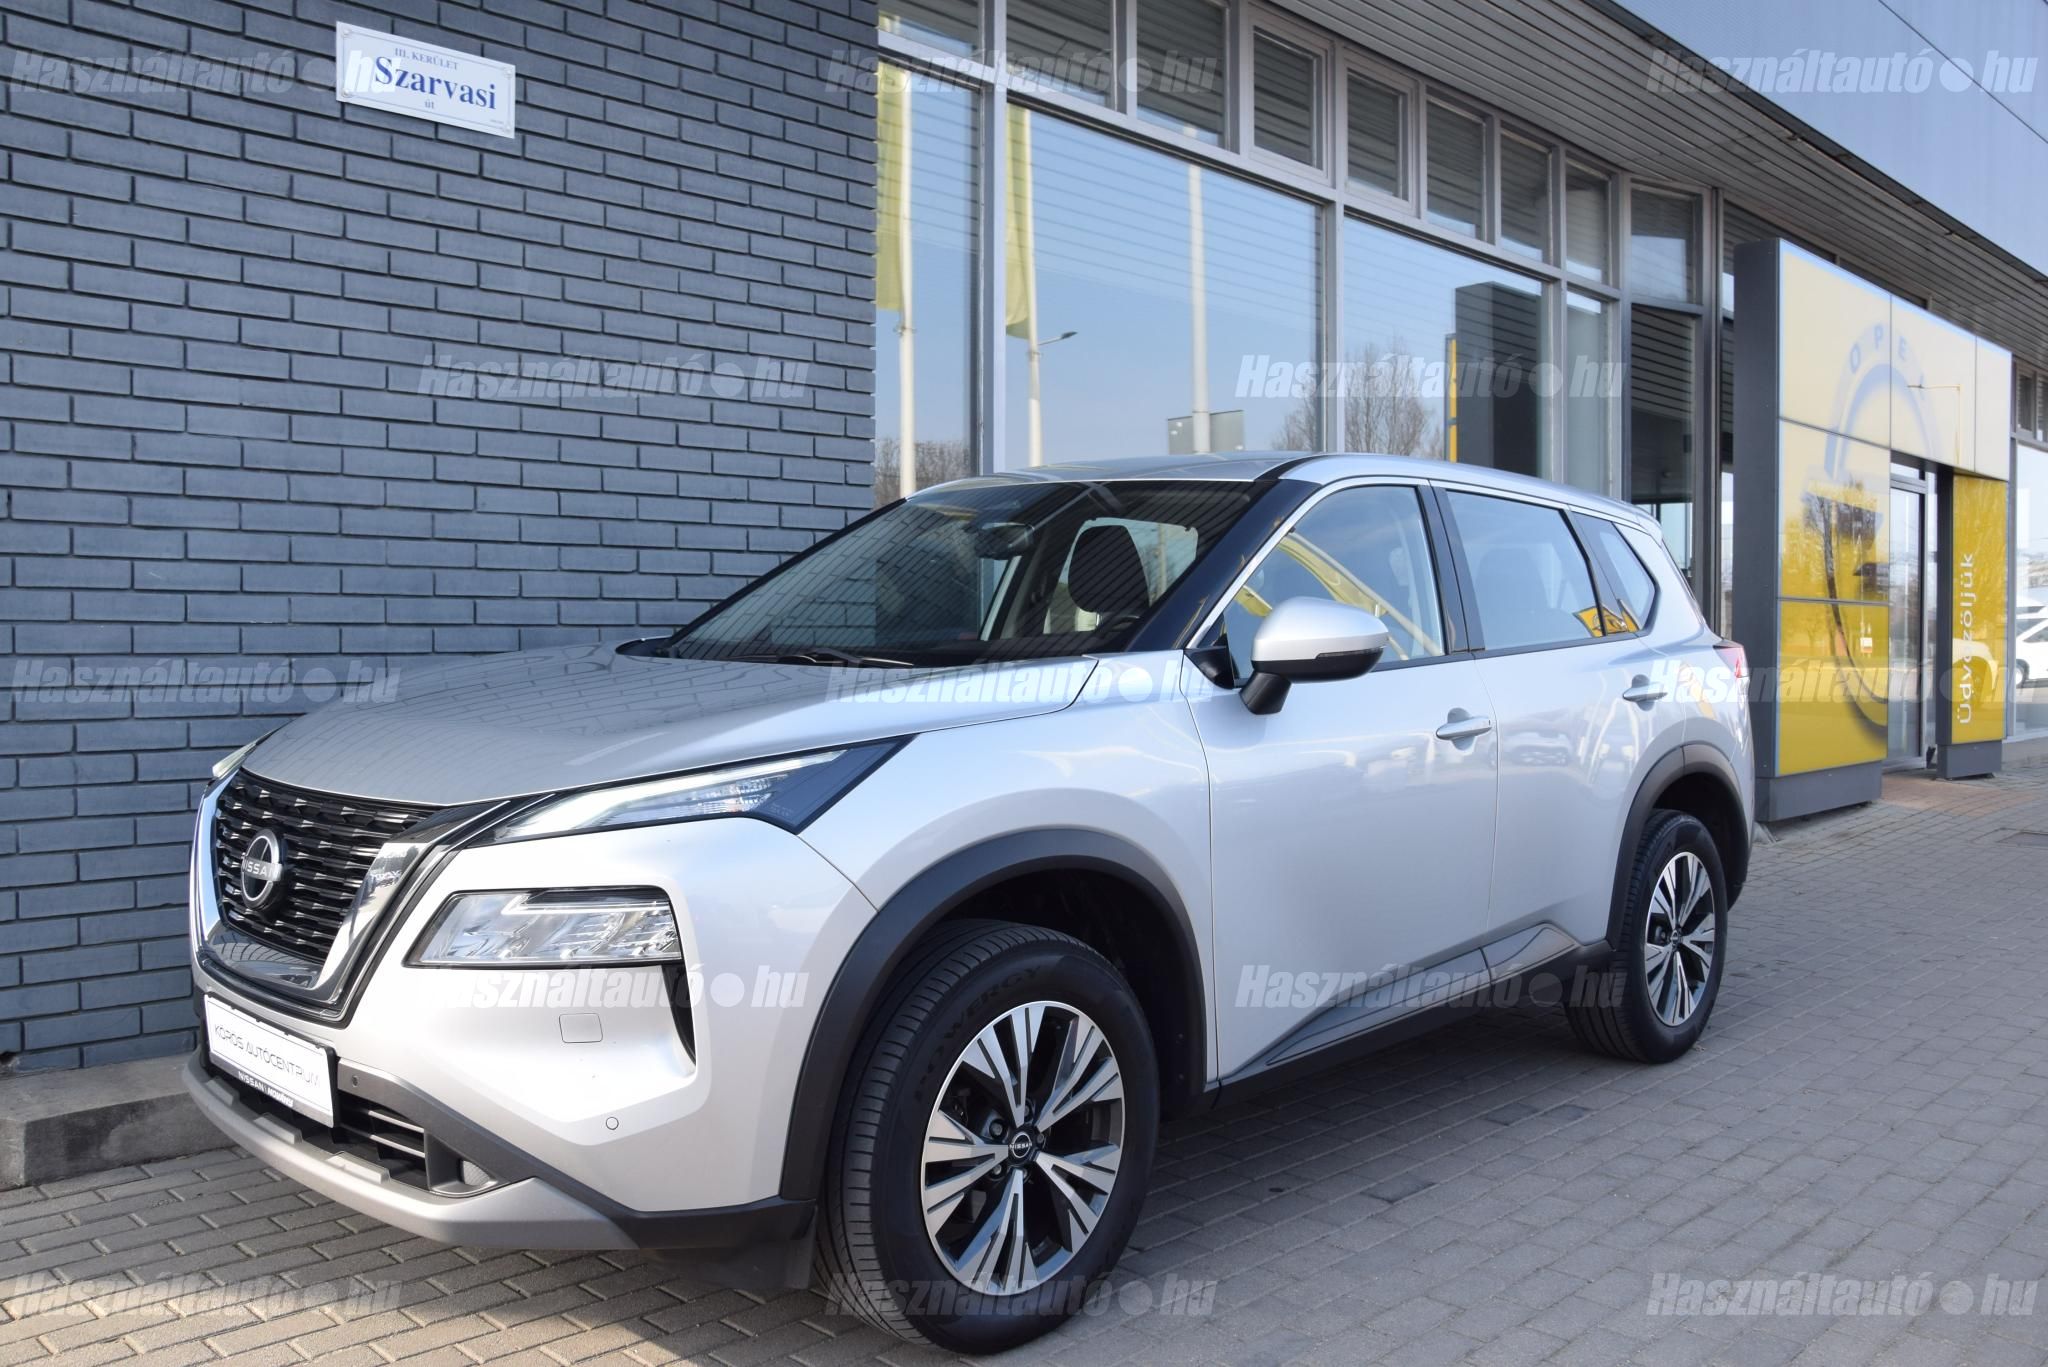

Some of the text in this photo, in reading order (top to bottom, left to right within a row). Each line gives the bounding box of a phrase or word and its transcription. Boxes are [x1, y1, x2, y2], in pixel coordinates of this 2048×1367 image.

[412, 50, 459, 71] KERÜLET
[374, 55, 497, 111] Szarvasi
[424, 100, 435, 110] út
